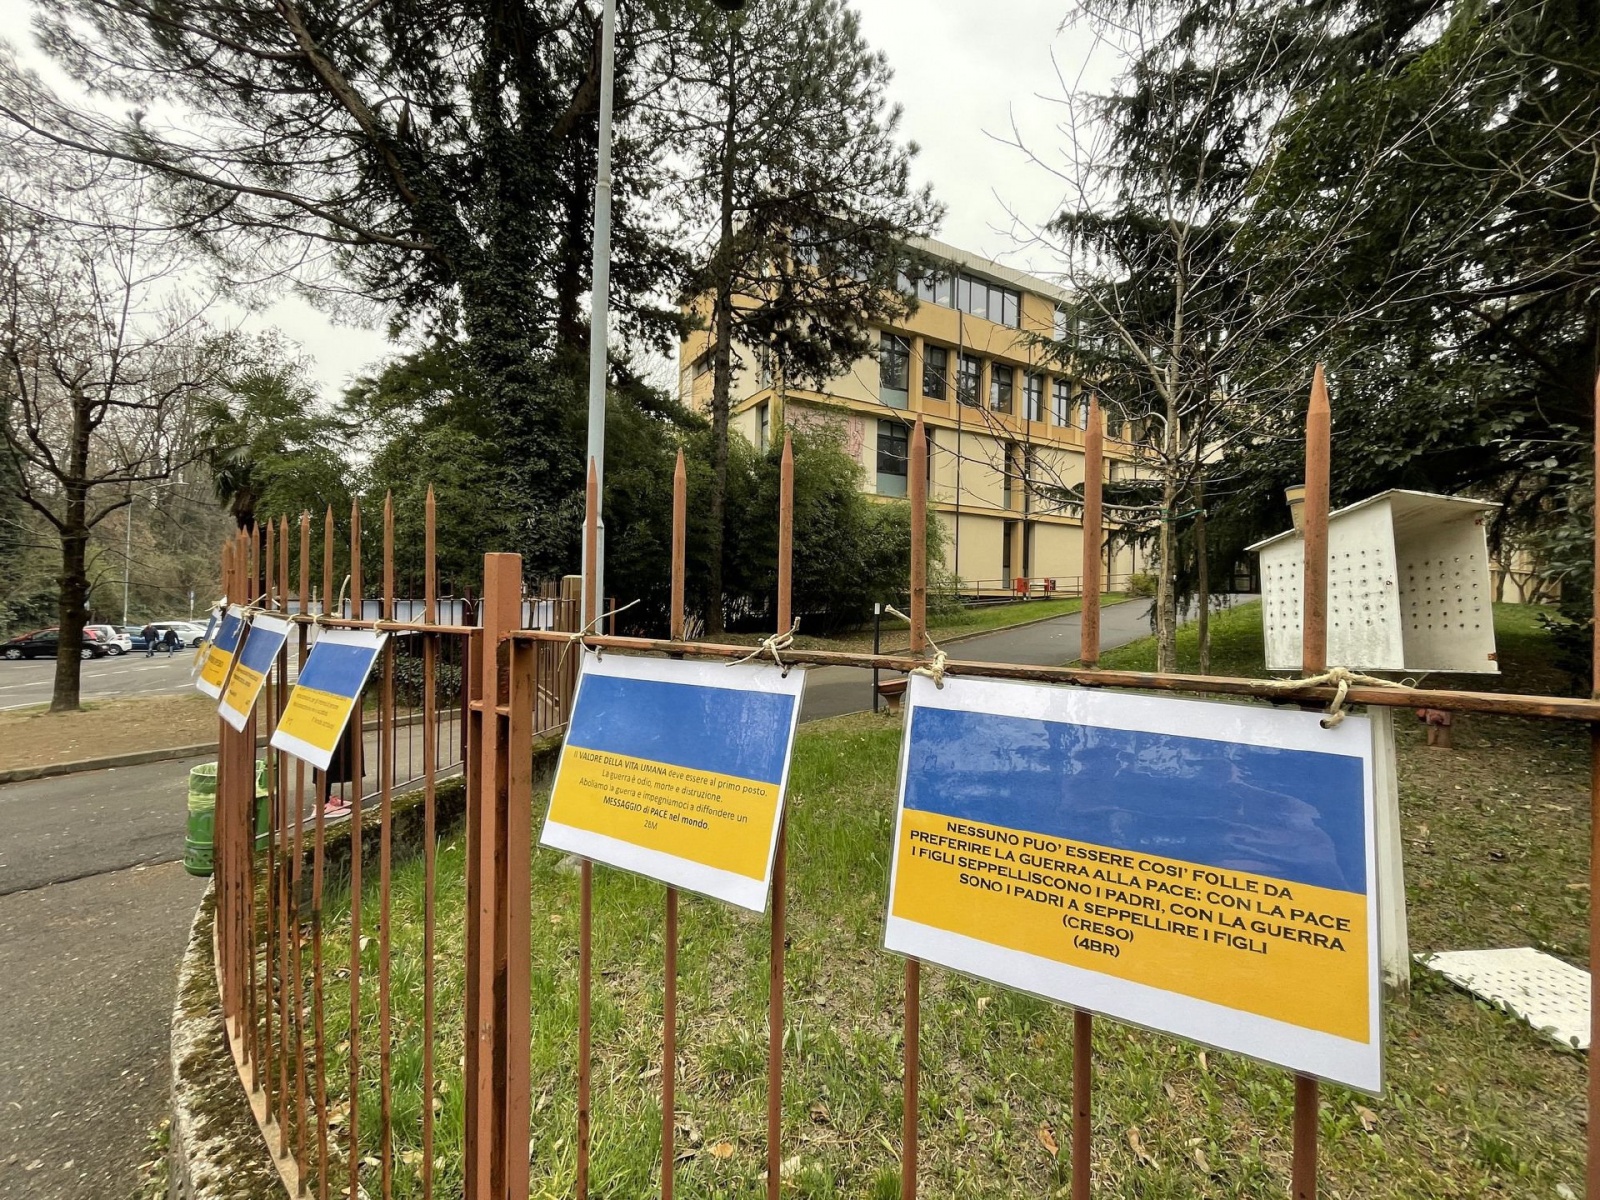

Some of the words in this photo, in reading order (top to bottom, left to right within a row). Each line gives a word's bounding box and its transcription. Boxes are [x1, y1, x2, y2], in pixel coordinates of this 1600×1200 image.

[579, 752, 602, 763] VALORE
[604, 757, 623, 767] DELLA
[625, 761, 638, 770] VITA
[641, 765, 667, 775] UMANA
[668, 770, 683, 779] deve
[686, 774, 708, 784] essere
[710, 778, 716, 786] al
[717, 780, 740, 791] primo
[742, 786, 767, 796] posto.
[610, 773, 630, 782] guerra
[632, 775, 636, 783] è
[637, 777, 653, 788] odio,
[654, 782, 674, 791] morte
[682, 787, 722, 802] distruzione.
[579, 777, 608, 790] Aboliamo
[615, 787, 636, 796] guerra
[643, 792, 689, 810] impegniamoci
[696, 804, 735, 820] diffondere
[737, 815, 748, 823] un
[603, 796, 642, 811] MESSAGGIO
[651, 808, 668, 819] PACE
[669, 812, 680, 821] nel
[681, 817, 709, 830] mondo.
[910, 830, 991, 856] PREFERIRE
[995, 848, 1015, 862] LA
[1019, 854, 1089, 877] GUERRA
[1093, 870, 1141, 889] ALLA
[1146, 880, 1201, 901] PACE:
[1207, 892, 1251, 912] CON
[1256, 902, 1286, 919] LA
[1290, 908, 1351, 932] PACE
[947, 822, 1019, 846] NESSUNO
[1066, 846, 1134, 870] ESSERE
[1192, 870, 1259, 893] FOLLE
[1264, 883, 1293, 900] DA
[911, 846, 916, 855] I
[919, 848, 955, 864] FIGLI
[958, 856, 1092, 895] SEPPELLISCONO
[1096, 886, 1101, 898] I
[1105, 889, 1165, 914] PADRI,
[1170, 903, 1213, 923] CON
[1218, 913, 1246, 930] LA
[1250, 920, 1346, 952] GUERRA
[959, 873, 1003, 892] SONO
[1006, 884, 1011, 894] I
[1014, 886, 1064, 907] PADRI
[1067, 899, 1080, 911] A
[1084, 902, 1199, 939] SEPPELLIRE
[1204, 929, 1209, 941] I
[1213, 931, 1267, 954] FIGLI
[1062, 914, 1134, 943] (CRESO)
[1074, 934, 1121, 958] (4BR)
